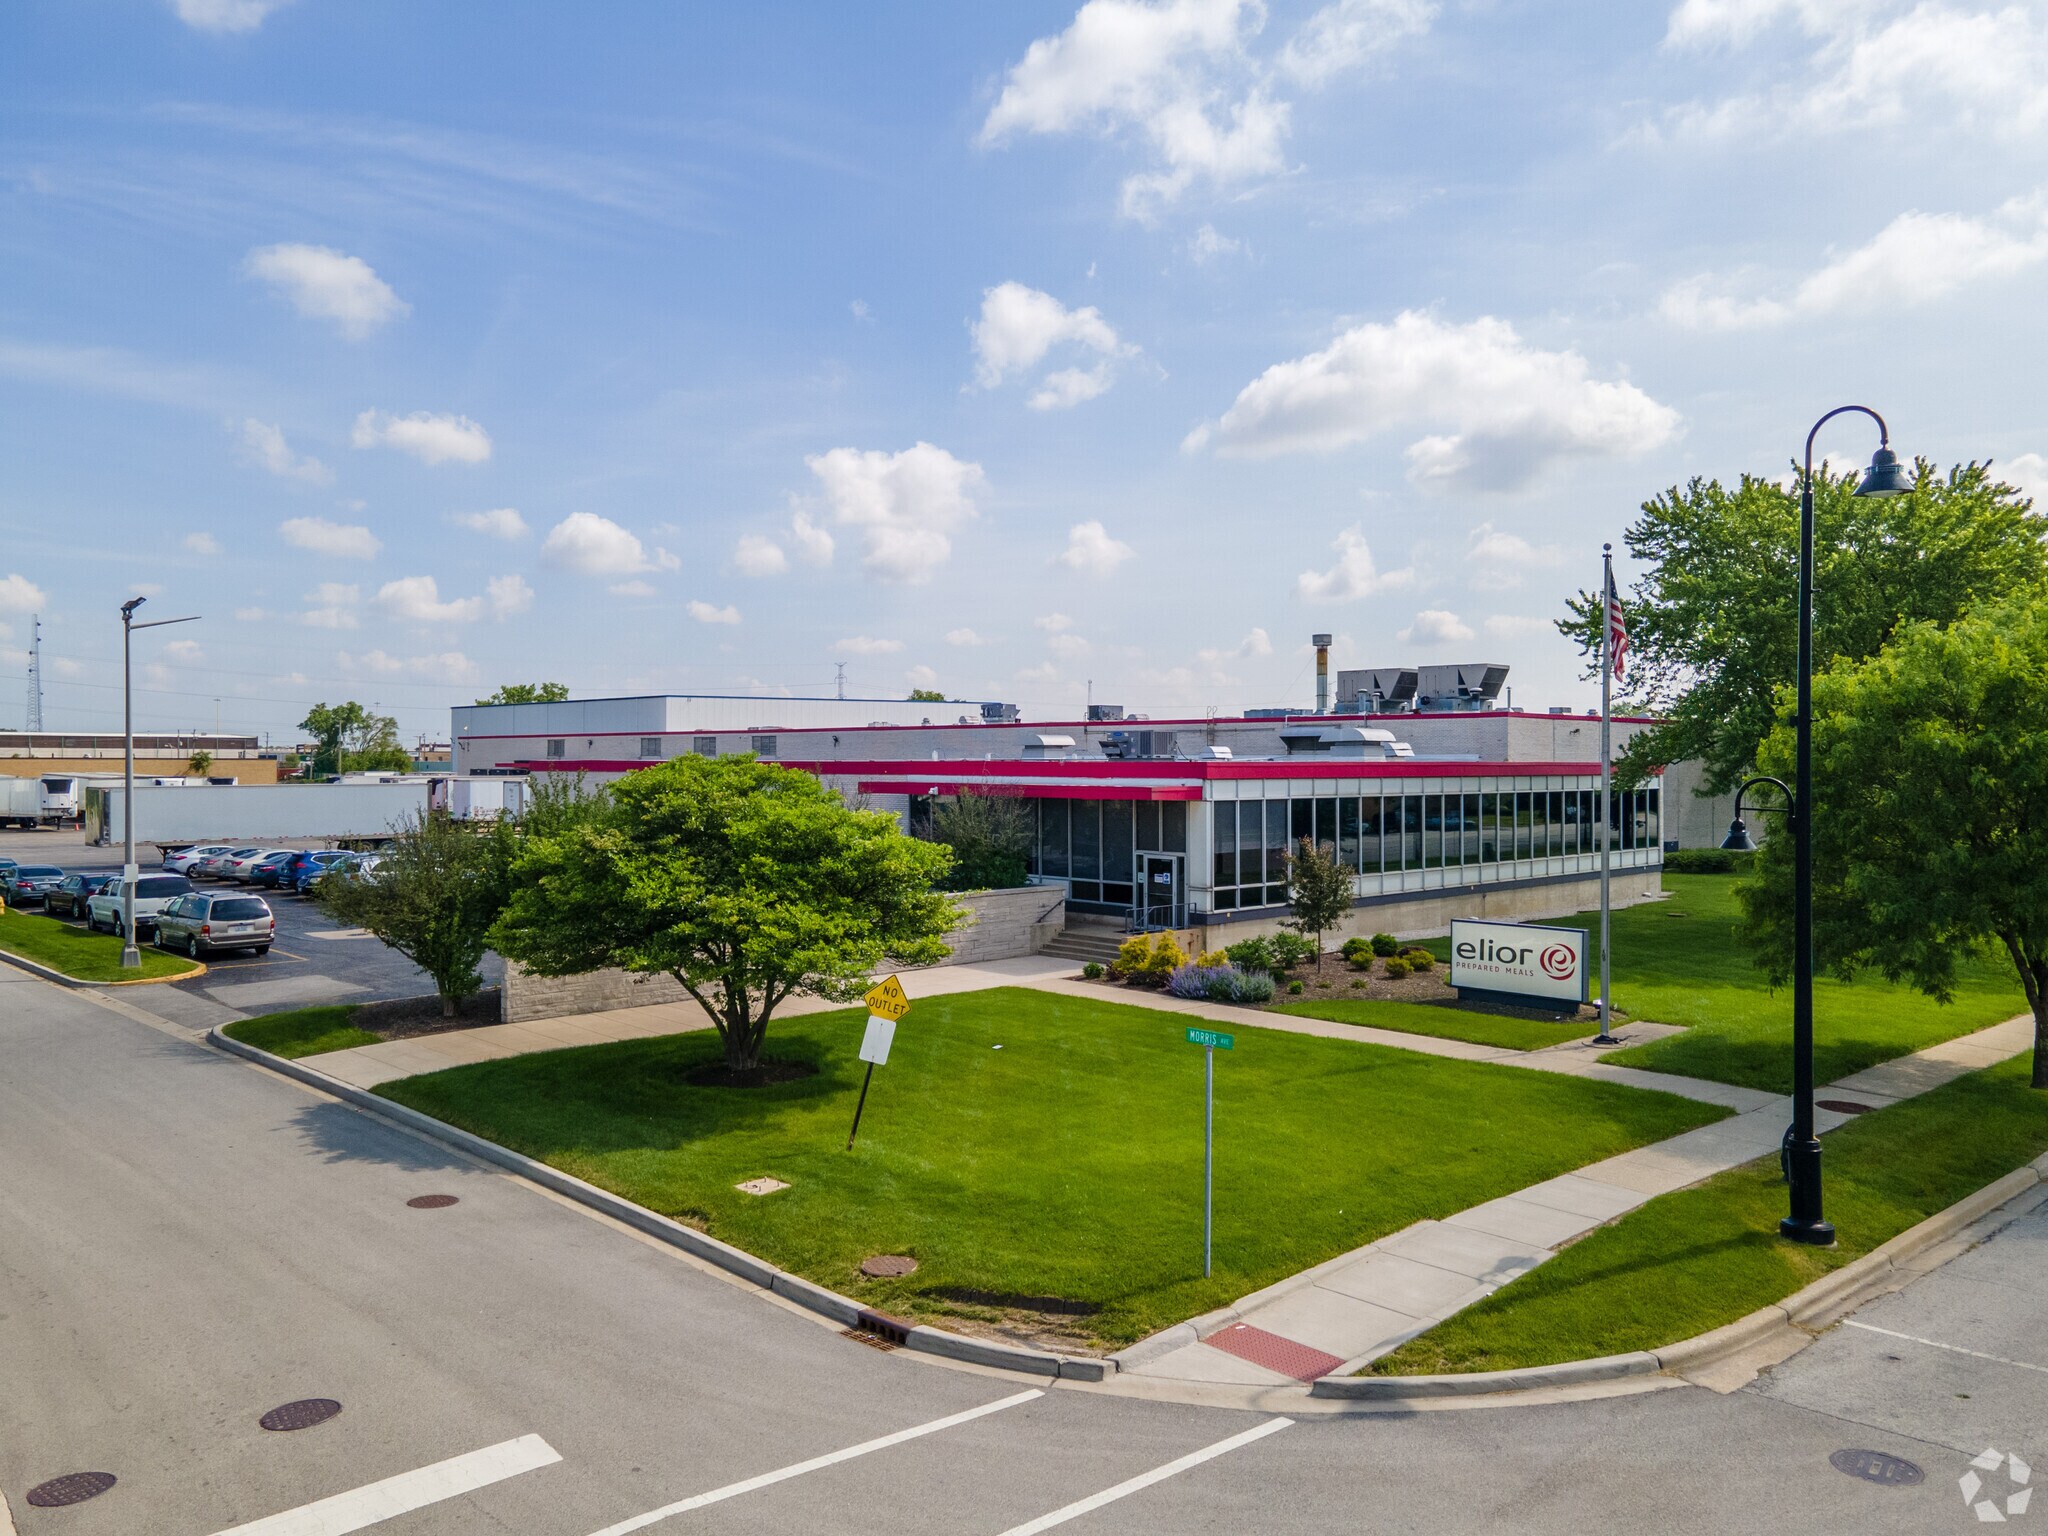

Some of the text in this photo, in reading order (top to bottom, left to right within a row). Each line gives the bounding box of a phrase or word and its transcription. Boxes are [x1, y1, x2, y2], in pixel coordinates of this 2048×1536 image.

[1456, 939, 1533, 965] elior
[1456, 962, 1534, 977] PREPARED MEALS
[883, 986, 898, 998] NO
[869, 996, 906, 1015] OUTLET
[1190, 1030, 1216, 1044] MORRIS
